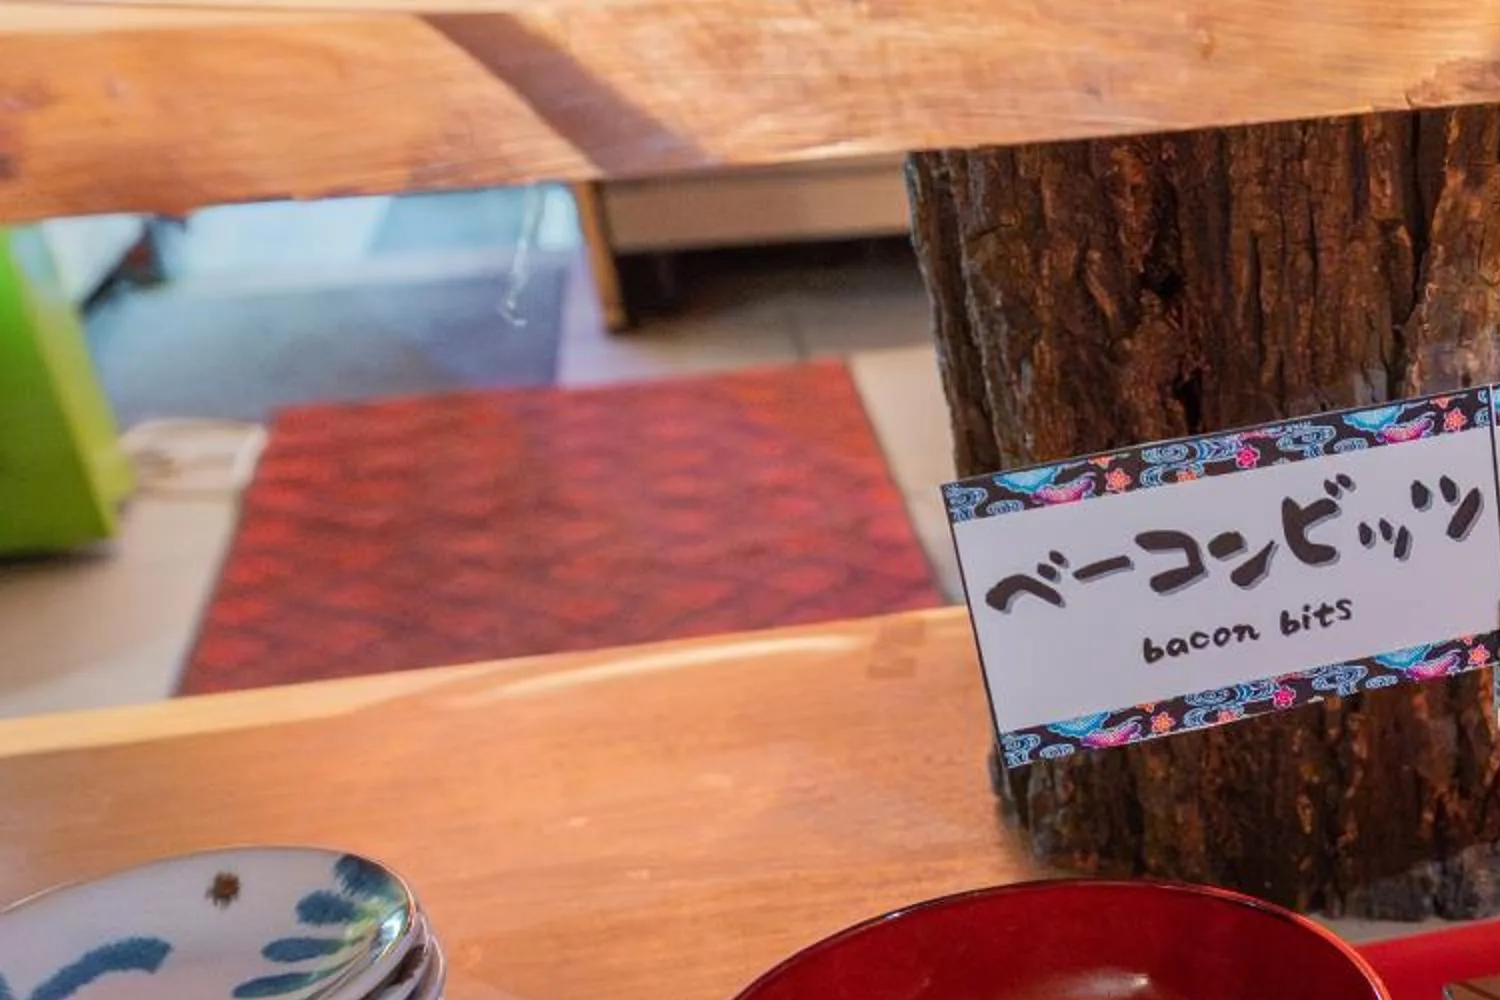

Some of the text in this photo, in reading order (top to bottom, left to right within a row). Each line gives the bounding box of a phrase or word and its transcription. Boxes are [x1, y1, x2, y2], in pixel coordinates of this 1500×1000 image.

[985, 474, 1483, 612] ベーコンビッツ
[1142, 598, 1353, 665] bacon bits
